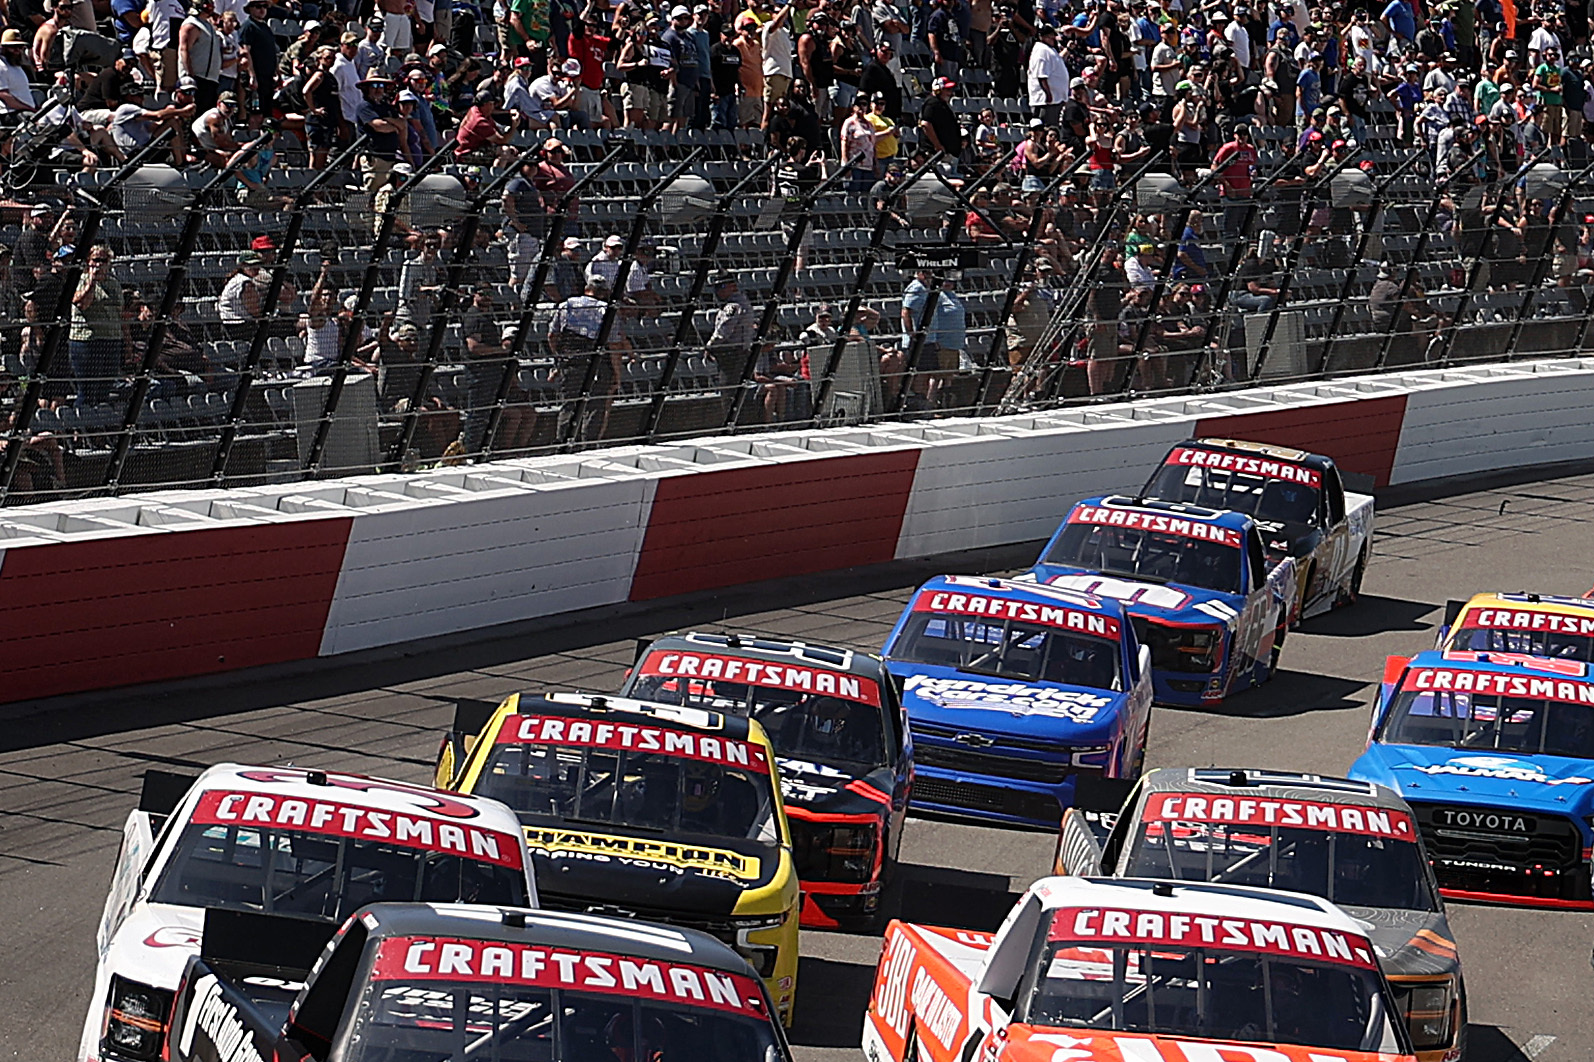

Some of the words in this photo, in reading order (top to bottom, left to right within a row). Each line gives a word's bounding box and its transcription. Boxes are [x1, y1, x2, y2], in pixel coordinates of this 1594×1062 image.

[916, 257, 959, 267] WHELEN
[1179, 450, 1310, 483] CRAFTSMAN
[1080, 506, 1226, 543] CRAFTSMAN
[931, 592, 1106, 635] CRAFTSMAN
[658, 654, 861, 699] CRAFTSMAN
[517, 717, 749, 766] CRAFTSMAN
[216, 795, 500, 861] CRAFTSMAN
[1160, 797, 1393, 835] CRAFTSMAN
[1444, 810, 1527, 832] TOYOTA
[522, 826, 750, 876] HAMPION
[1441, 859, 1517, 873] TUNDRA
[1073, 911, 1357, 962] CRAFTSMAN
[403, 942, 743, 1009] CRAFTSMAN
[877, 927, 917, 1040] JBL
